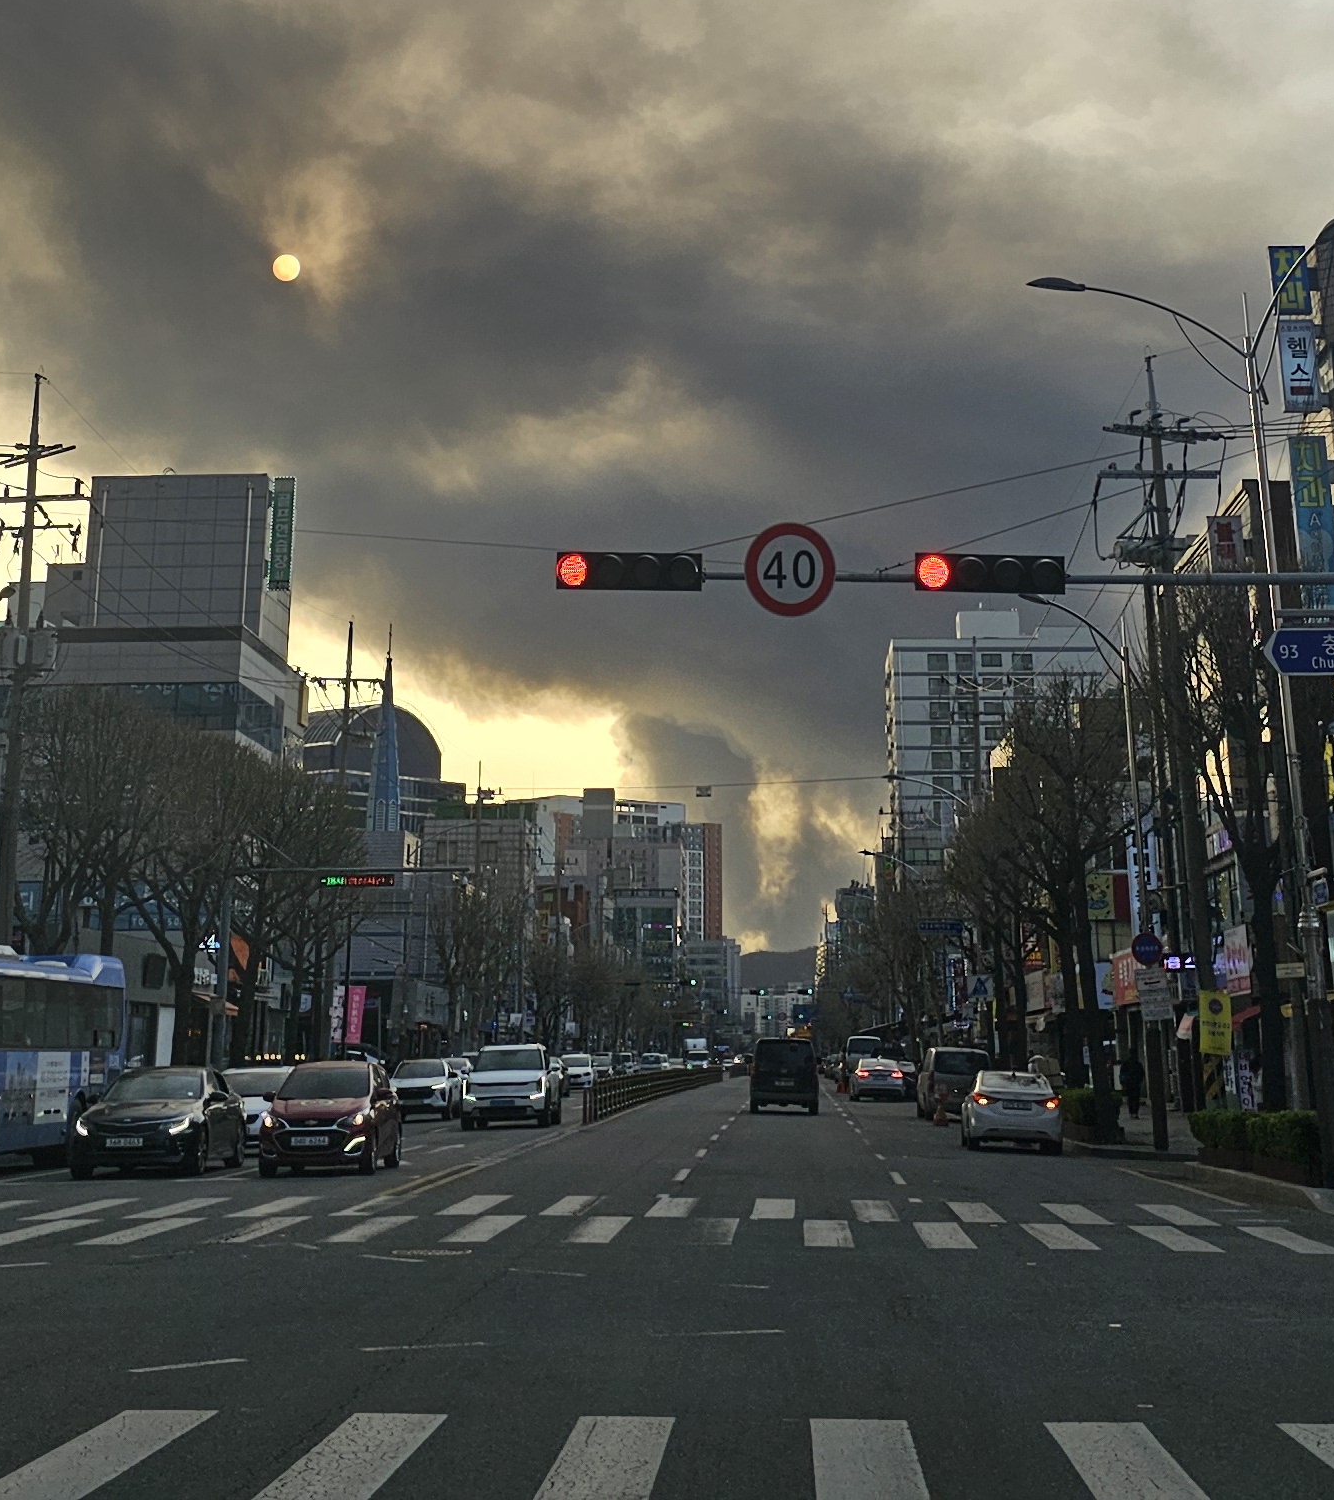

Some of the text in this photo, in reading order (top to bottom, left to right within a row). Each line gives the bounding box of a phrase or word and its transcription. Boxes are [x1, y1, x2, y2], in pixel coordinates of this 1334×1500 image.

[1274, 250, 1308, 310] 치과
[1286, 336, 1312, 383] 헬스
[1293, 439, 1328, 507] 치과
[762, 549, 817, 590] 40
[1279, 644, 1301, 660] 93
